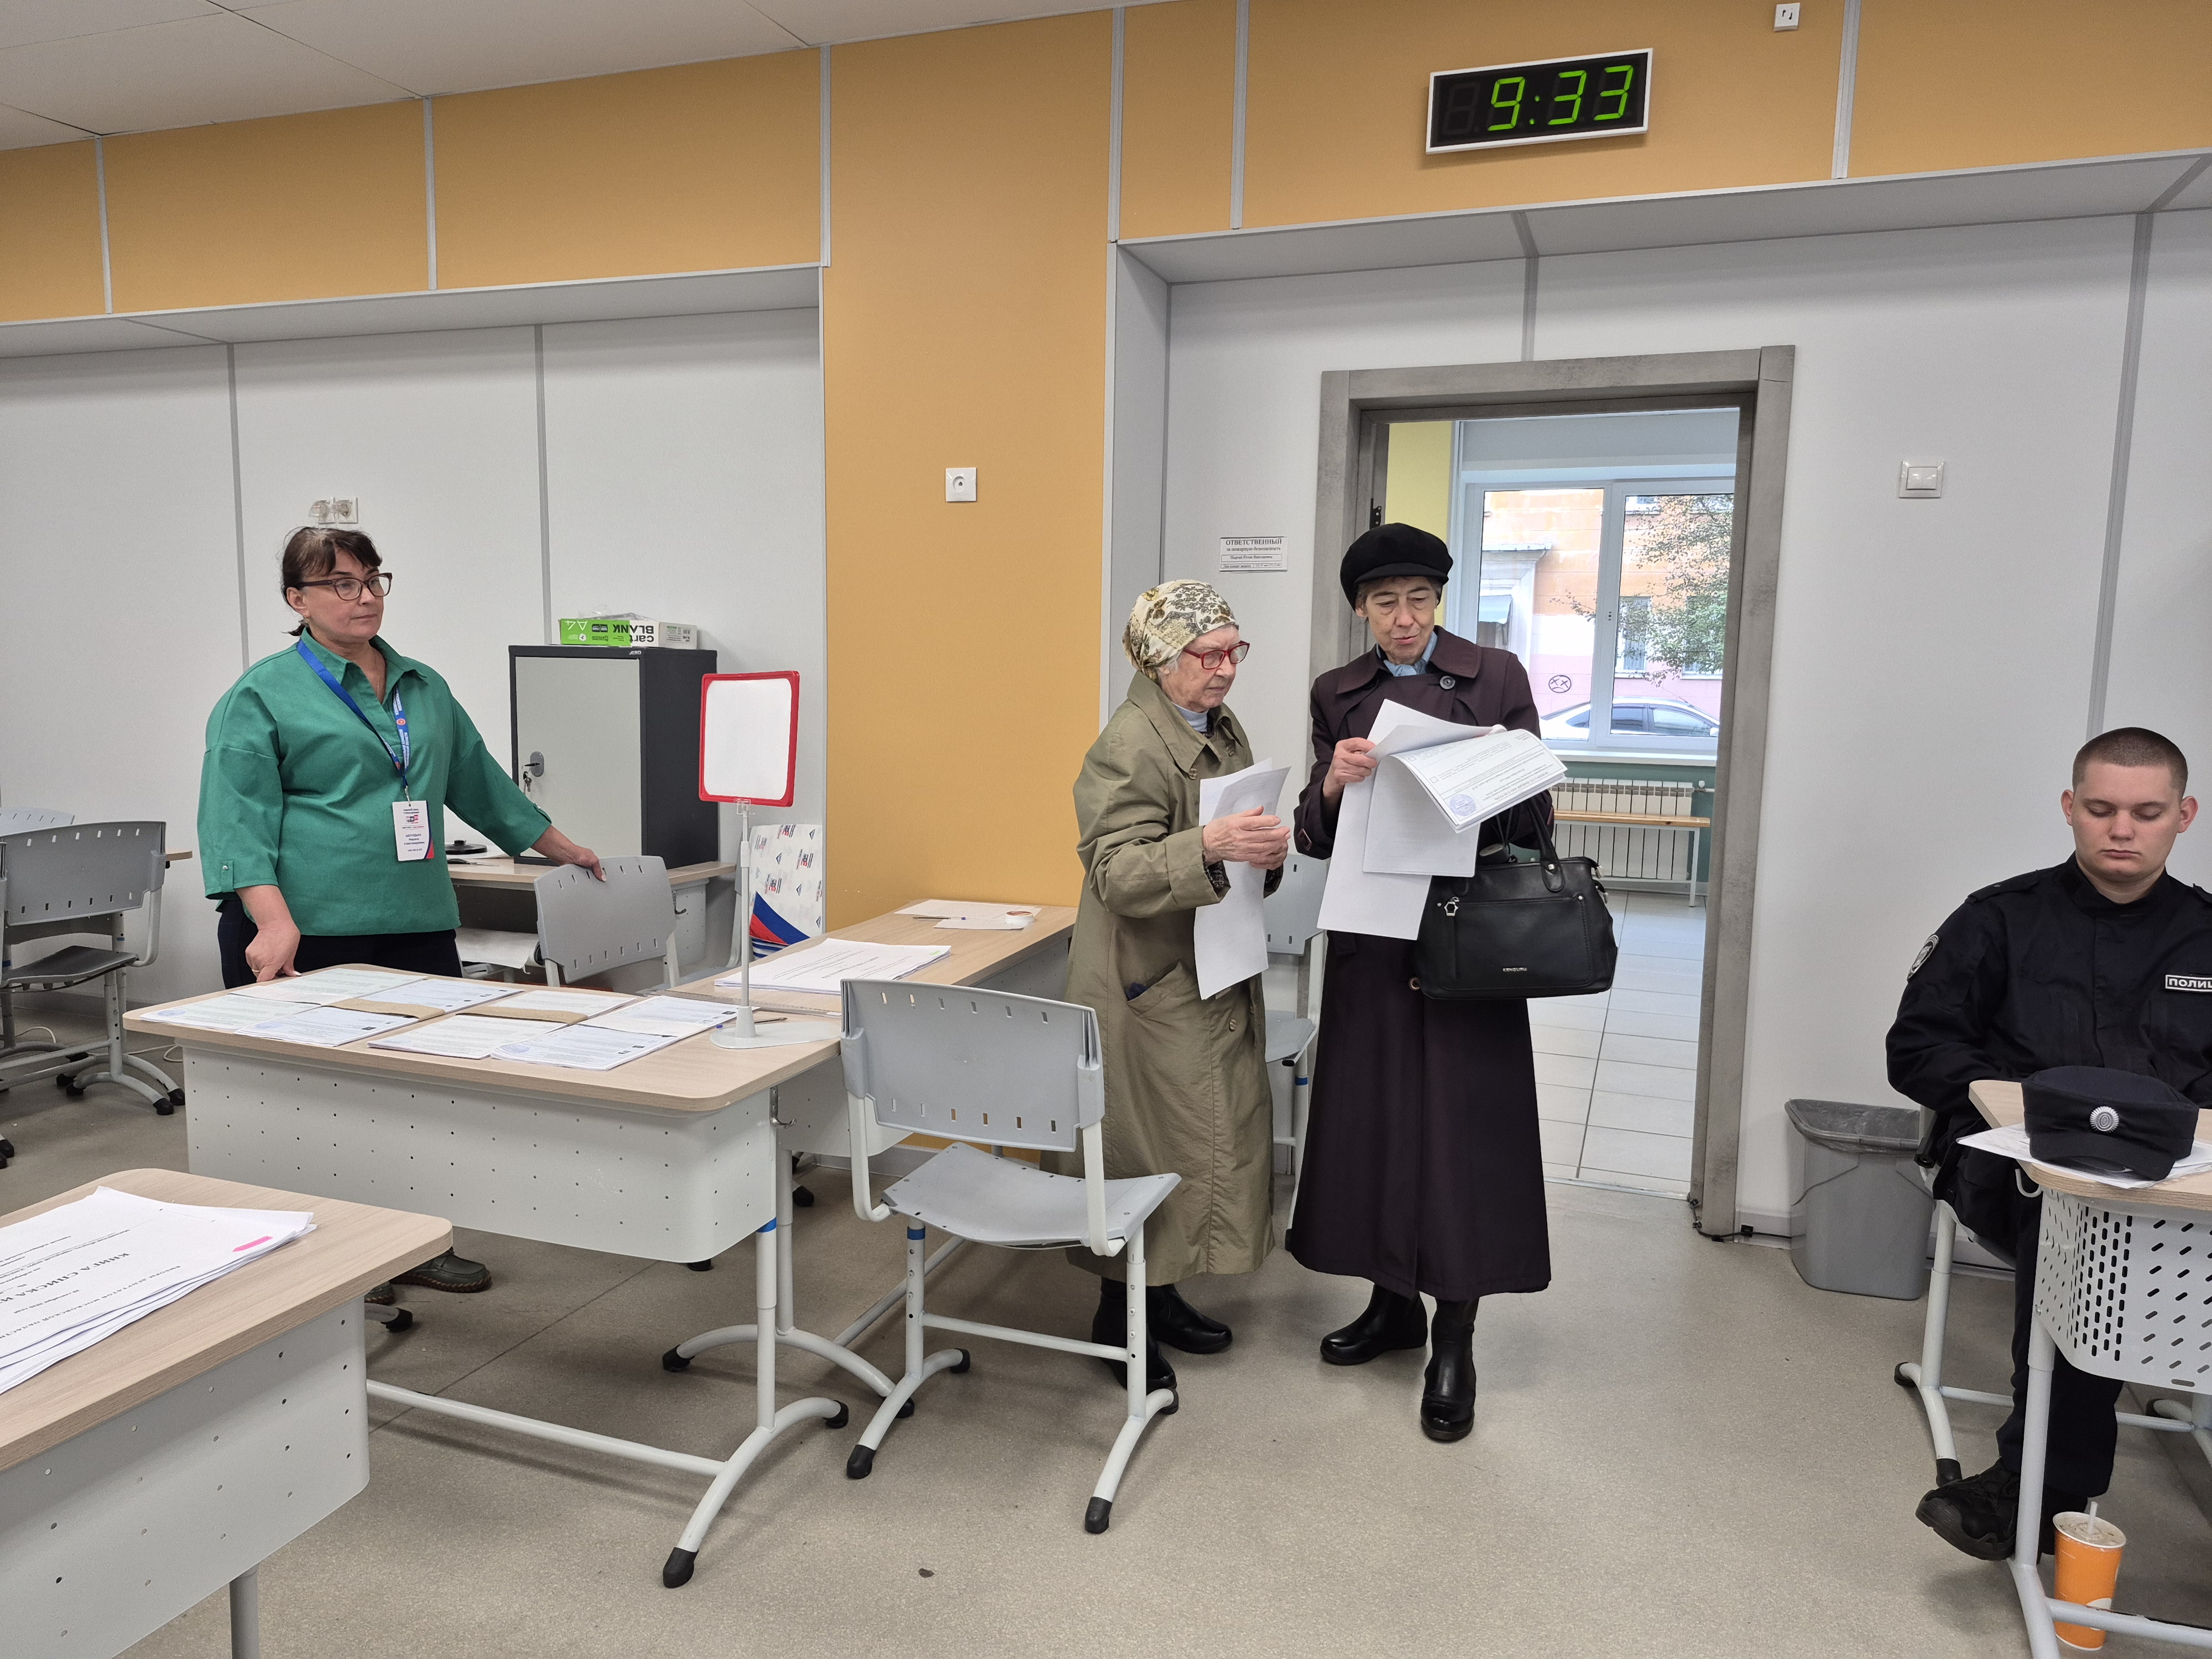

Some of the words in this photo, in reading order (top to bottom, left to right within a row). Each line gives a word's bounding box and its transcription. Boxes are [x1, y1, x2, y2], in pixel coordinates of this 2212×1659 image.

[1487, 65, 1634, 131] 9:33
[565, 620, 587, 631] A4
[612, 624, 654, 634] BLANK
[15, 1272, 79, 1296] СПИСКА
[101, 1278, 147, 1298] ДЕПУТАТОВ
[42, 1298, 100, 1321] МОСКОВСКОЙ
